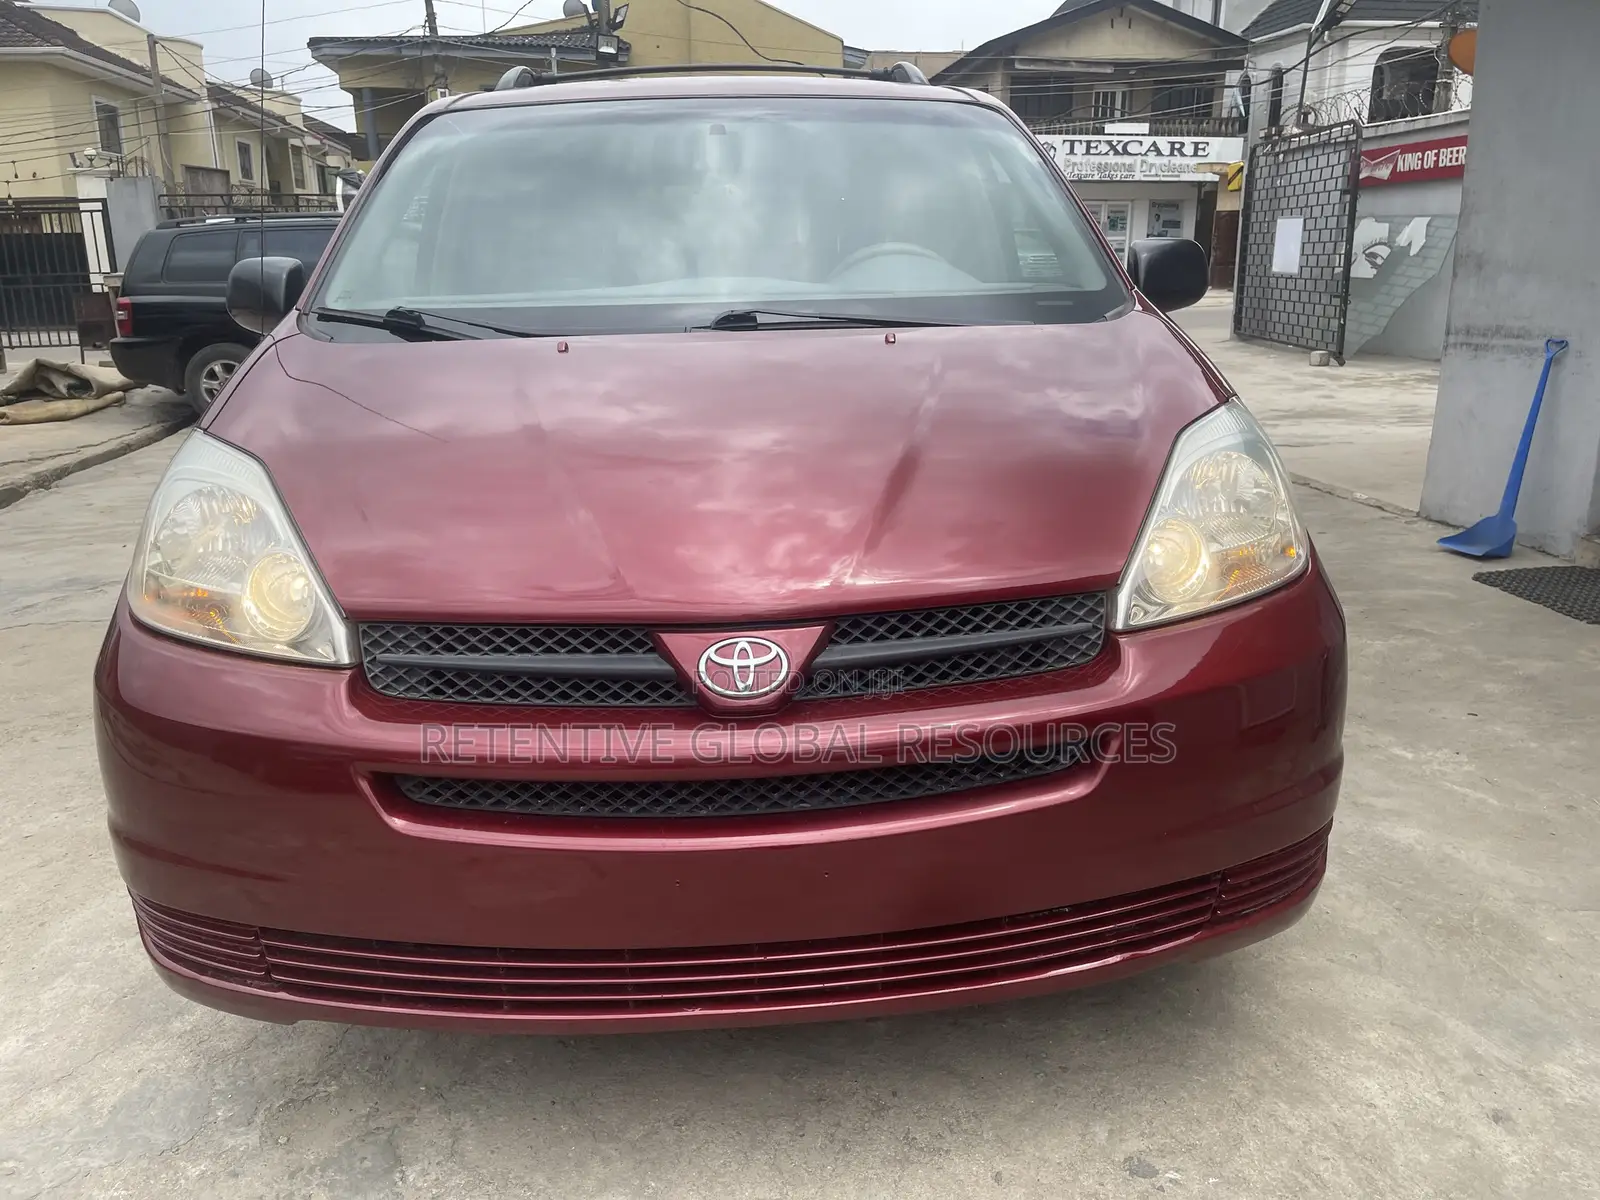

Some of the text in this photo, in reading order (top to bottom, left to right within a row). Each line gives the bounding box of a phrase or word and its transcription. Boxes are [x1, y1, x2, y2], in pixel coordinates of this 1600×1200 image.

[1062, 139, 1210, 158] TEXCARE
[1064, 157, 1137, 173] Professional
[1397, 152, 1422, 172] KING
[1423, 150, 1438, 169] OF
